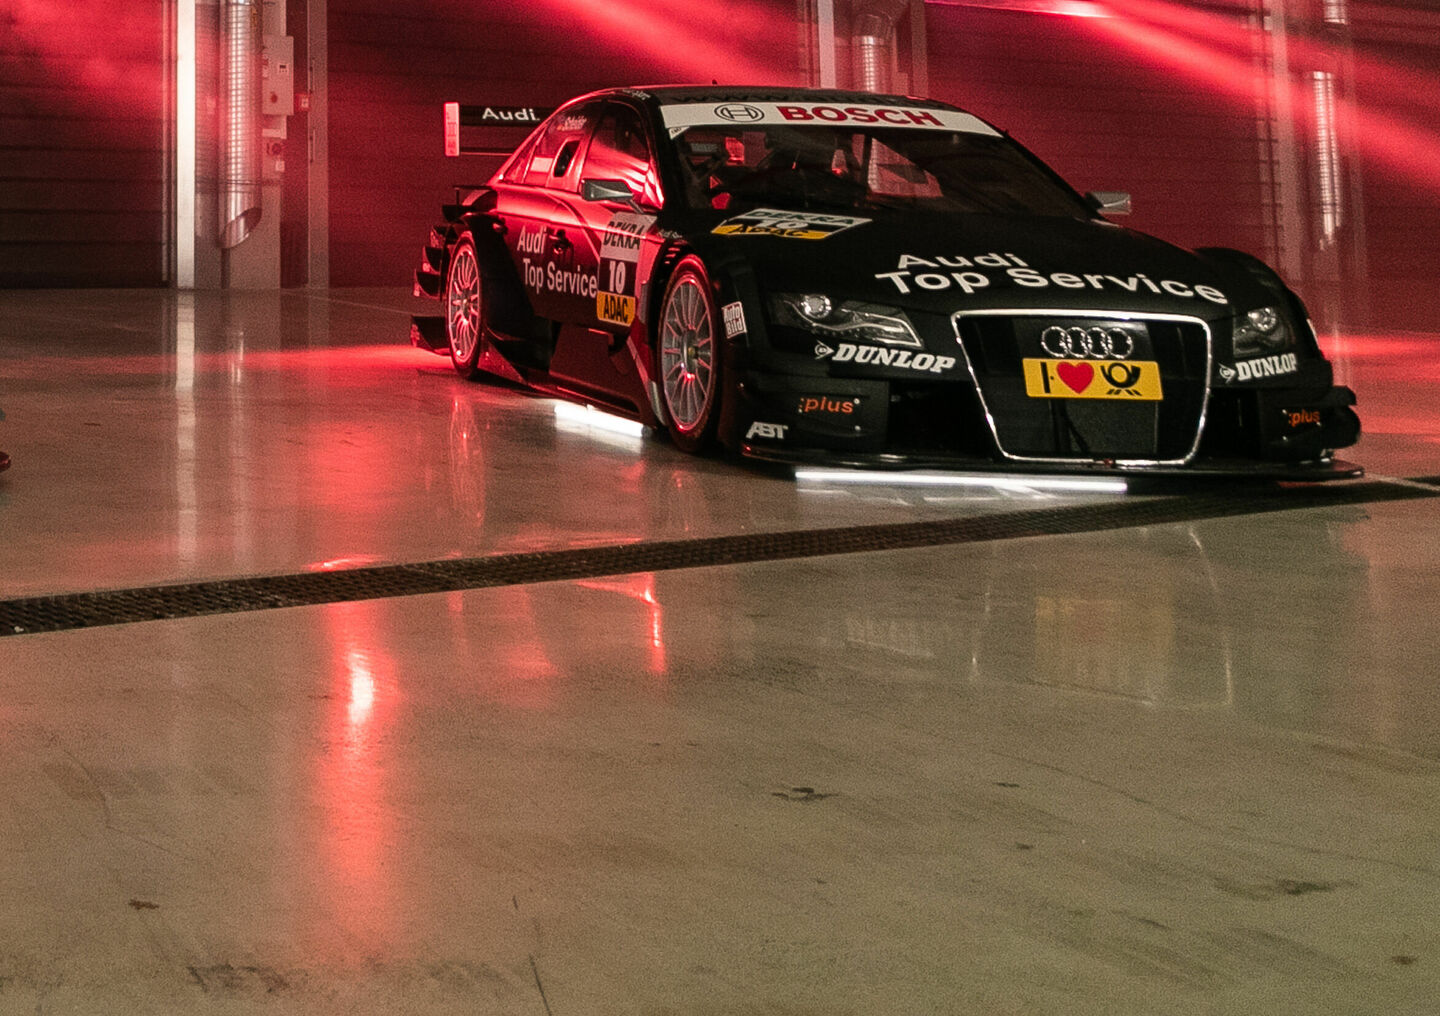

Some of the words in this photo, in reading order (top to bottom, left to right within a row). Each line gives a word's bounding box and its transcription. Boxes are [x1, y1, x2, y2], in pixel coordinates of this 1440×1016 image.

[776, 105, 946, 127] BOSCH
[745, 211, 854, 225] DEKRA
[517, 225, 548, 254] Audi
[603, 220, 645, 250] DEKRA
[897, 253, 1029, 269] Audi
[523, 258, 544, 295] Top
[547, 261, 598, 298] Service
[609, 260, 626, 294] 10
[875, 271, 990, 294] Top
[1006, 268, 1229, 304] Service
[603, 297, 629, 323] ADAC
[832, 343, 956, 374] DUNLOP
[1235, 352, 1298, 381] DUNLOP
[745, 421, 788, 440] ABT
